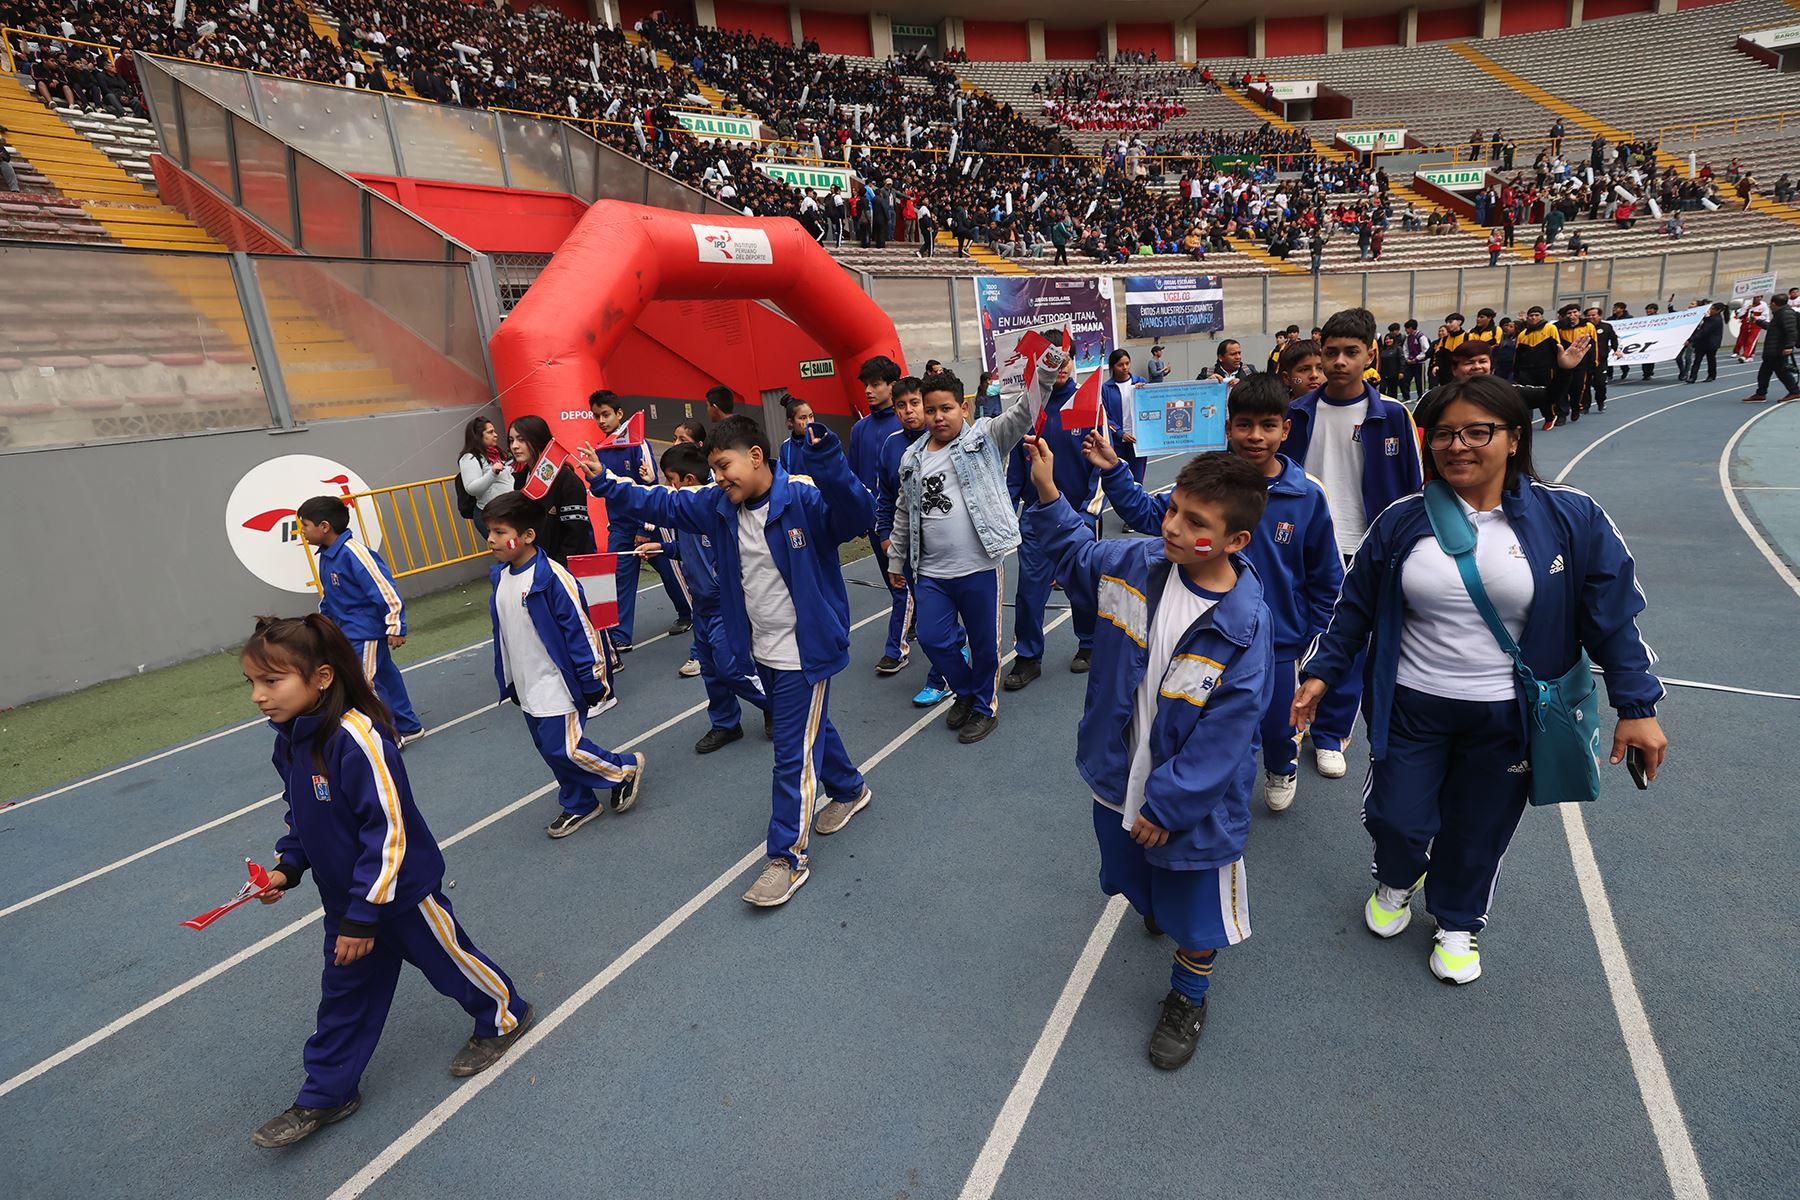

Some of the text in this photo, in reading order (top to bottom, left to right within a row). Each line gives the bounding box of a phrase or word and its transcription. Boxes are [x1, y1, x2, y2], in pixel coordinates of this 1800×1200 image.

[679, 117, 751, 136] SALIDA
[769, 169, 846, 189] SALIDA
[1427, 172, 1481, 184] SALIDA
[714, 241, 727, 249] IPD
[1163, 291, 1191, 302] UGEL 03
[1161, 304, 1185, 315] NUESTROS
[1185, 303, 1214, 314] ESTUDIANTES
[998, 311, 1098, 328] EN LIMA METROPOLITANA,
[1163, 316, 1178, 327] POR
[1177, 315, 1186, 326] EL
[1070, 322, 1105, 334] ERMANA
[1622, 340, 1659, 355] er
[811, 361, 833, 375] SALIDA
[561, 410, 594, 421] DEPOR
[1277, 531, 1289, 542] SJ
[317, 783, 329, 796] SJ
